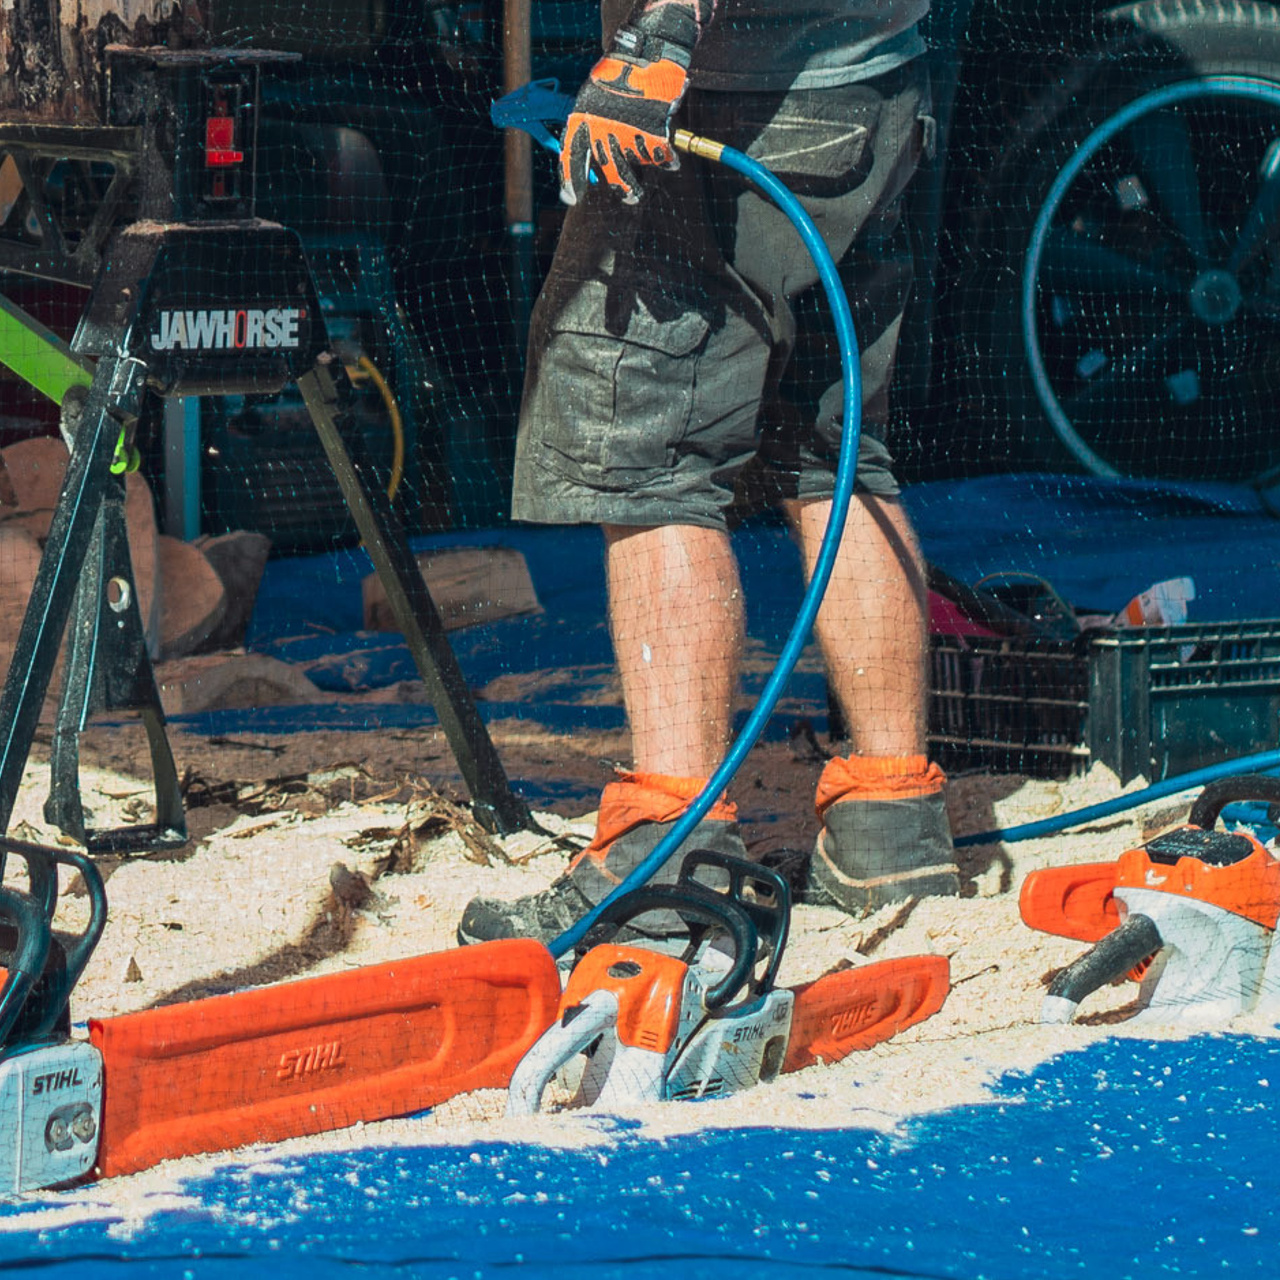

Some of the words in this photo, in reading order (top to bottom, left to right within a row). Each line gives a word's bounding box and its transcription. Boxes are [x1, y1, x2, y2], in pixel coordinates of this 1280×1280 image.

[151, 309, 299, 350] JAWHORSE
[733, 1023, 764, 1043] STIHL
[276, 1041, 346, 1080] STIHL
[32, 1068, 83, 1096] STIHL
